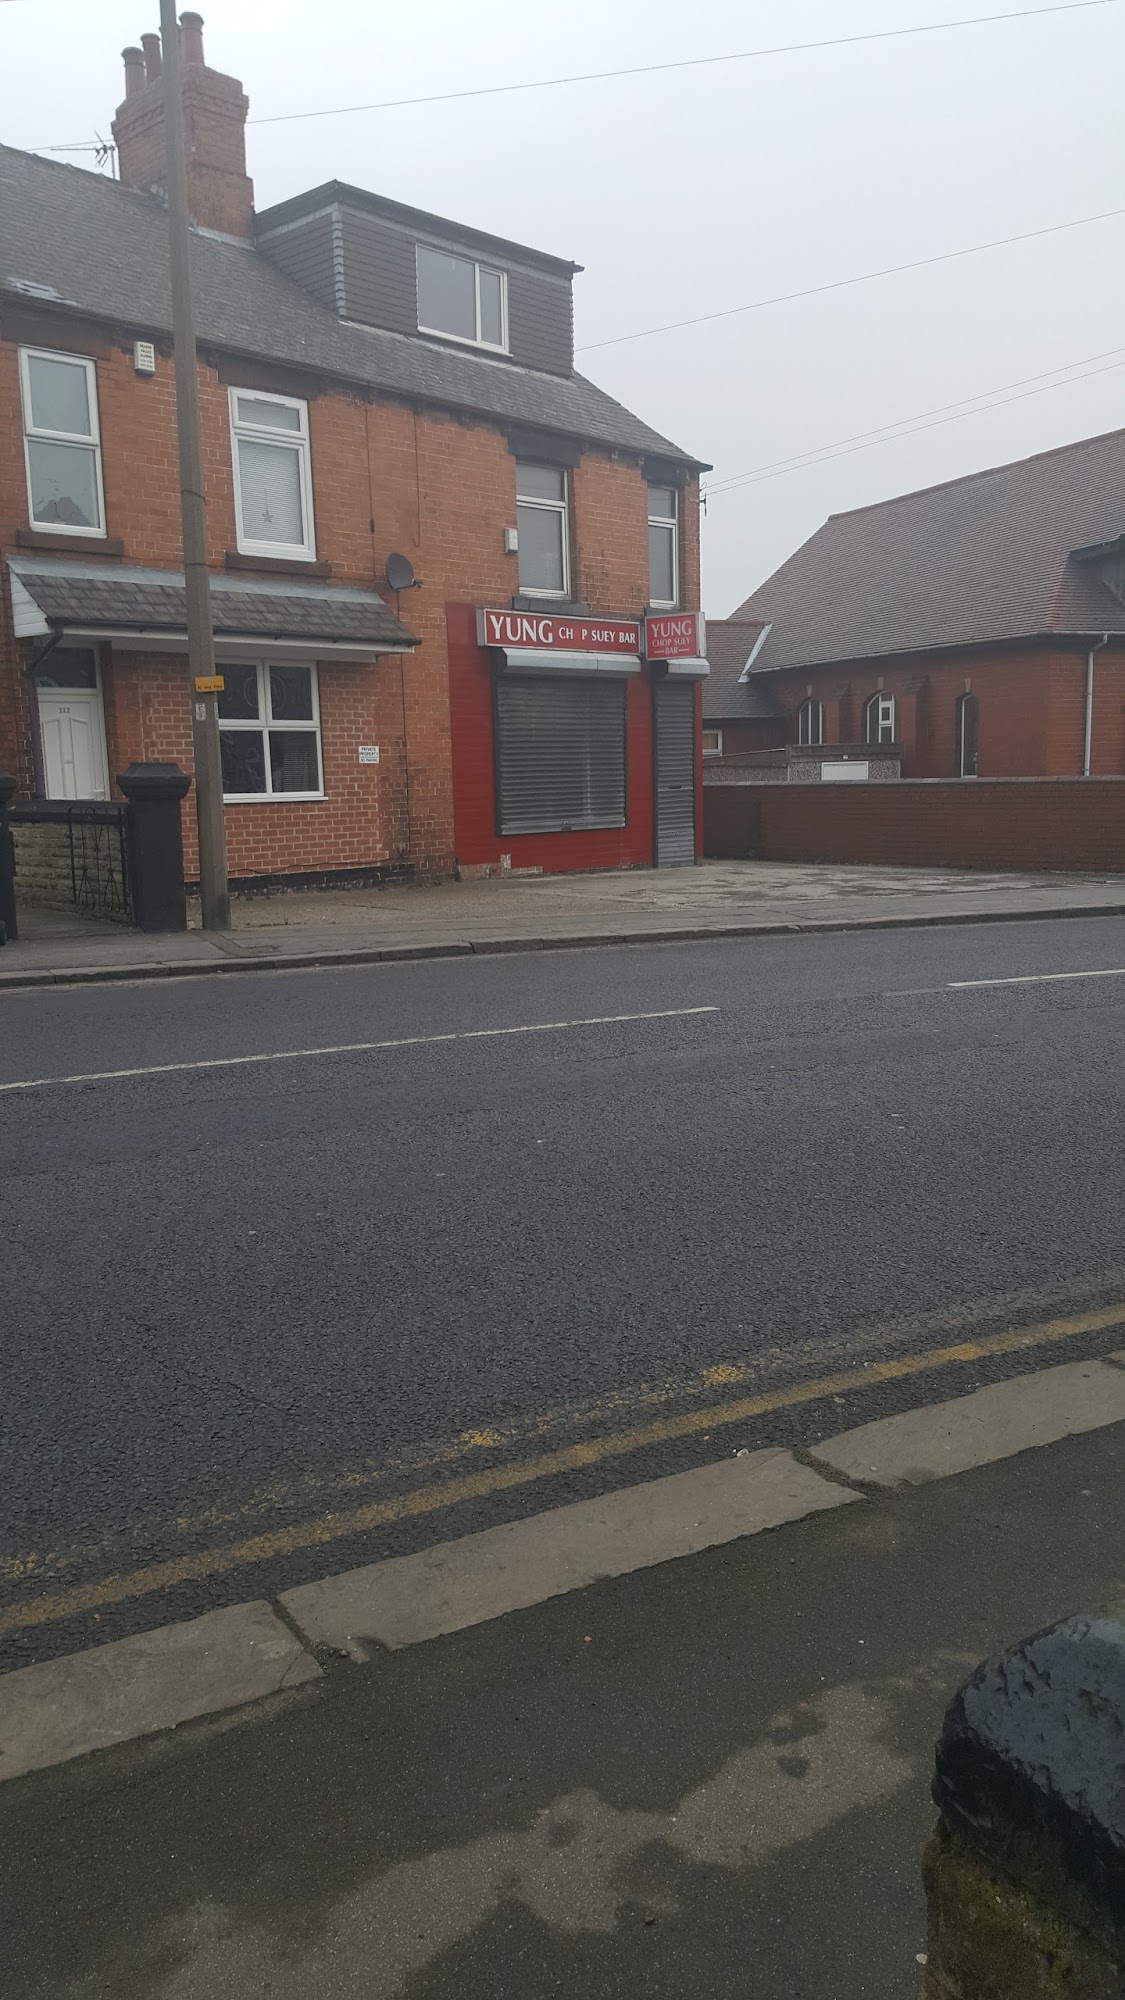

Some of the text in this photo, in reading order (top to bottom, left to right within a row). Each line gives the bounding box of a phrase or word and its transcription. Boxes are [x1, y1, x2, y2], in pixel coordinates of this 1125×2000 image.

[489, 615, 553, 643] YUNG
[591, 630, 616, 642] SUEY
[618, 632, 636, 643] BAR
[651, 620, 692, 638] YUNG
[652, 637, 691, 647] CHOP SUEY
[664, 646, 679, 655] BAR
